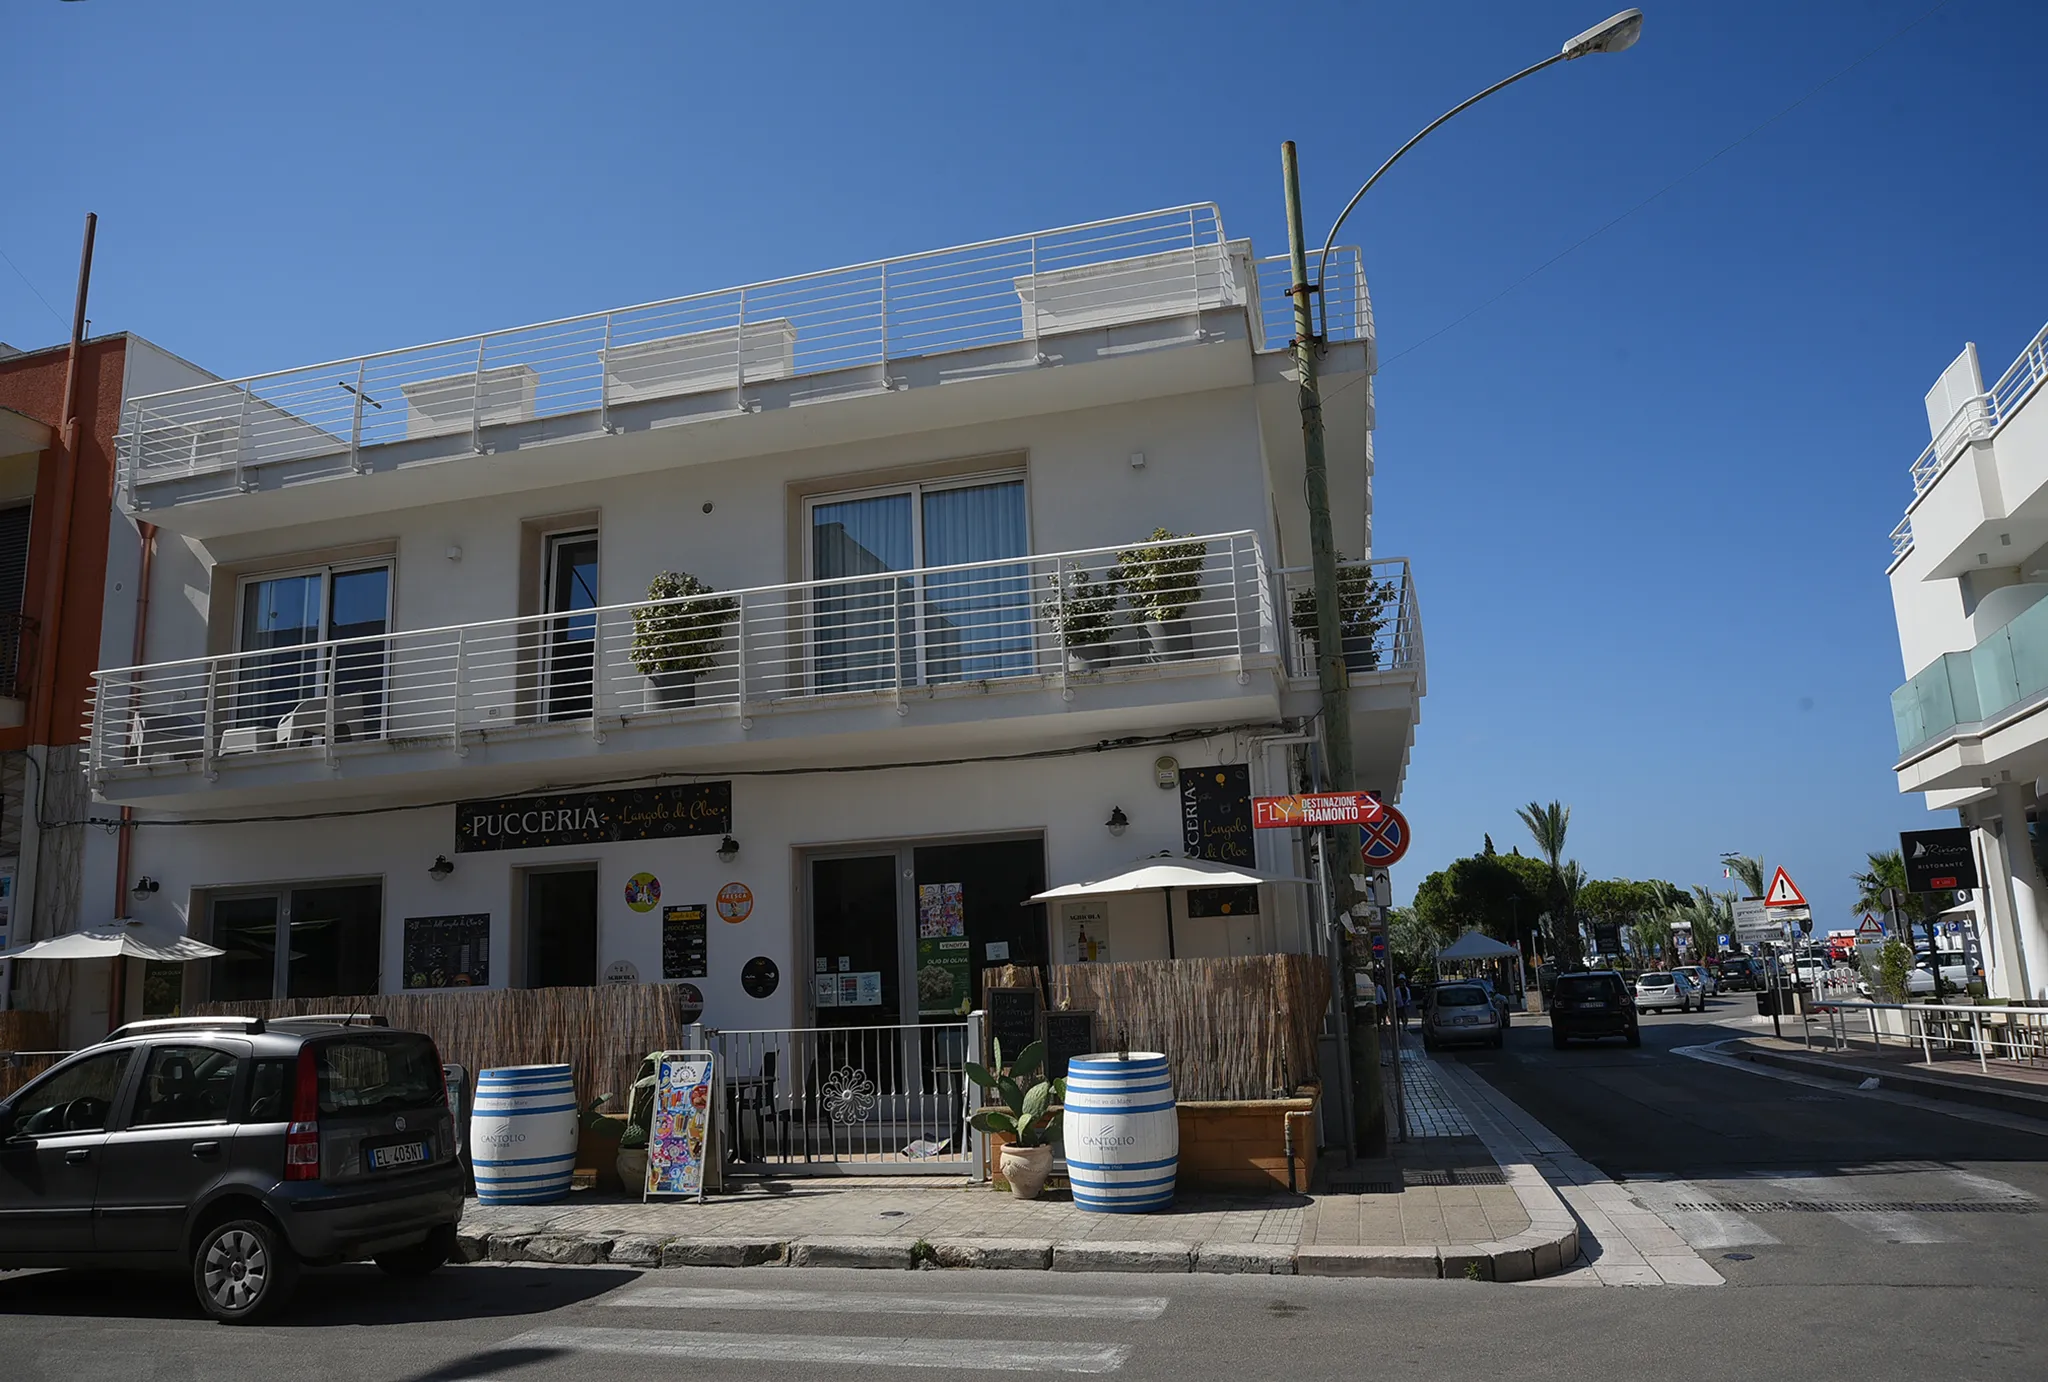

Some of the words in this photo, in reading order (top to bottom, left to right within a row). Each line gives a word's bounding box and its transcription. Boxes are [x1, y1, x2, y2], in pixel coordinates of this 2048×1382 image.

[1301, 796, 1357, 809] DESTINAZIONE
[473, 807, 600, 837] PUCCERIA
[673, 801, 687, 818] di
[690, 800, 720, 820] Cloe
[1256, 801, 1294, 824] FLY
[1302, 807, 1359, 822] TRAMONTO
[1183, 786, 1201, 859] CCERIA
[1204, 843, 1218, 858] di
[1220, 841, 1248, 860] Cloe
[1917, 861, 1965, 870] RISTORANTE
[1949, 923, 1957, 931] P
[481, 1134, 526, 1143] CANTOLIO
[1083, 1136, 1135, 1146] CANTOLIO
[376, 1149, 390, 1165] EL
[394, 1144, 422, 1162] 403NT
